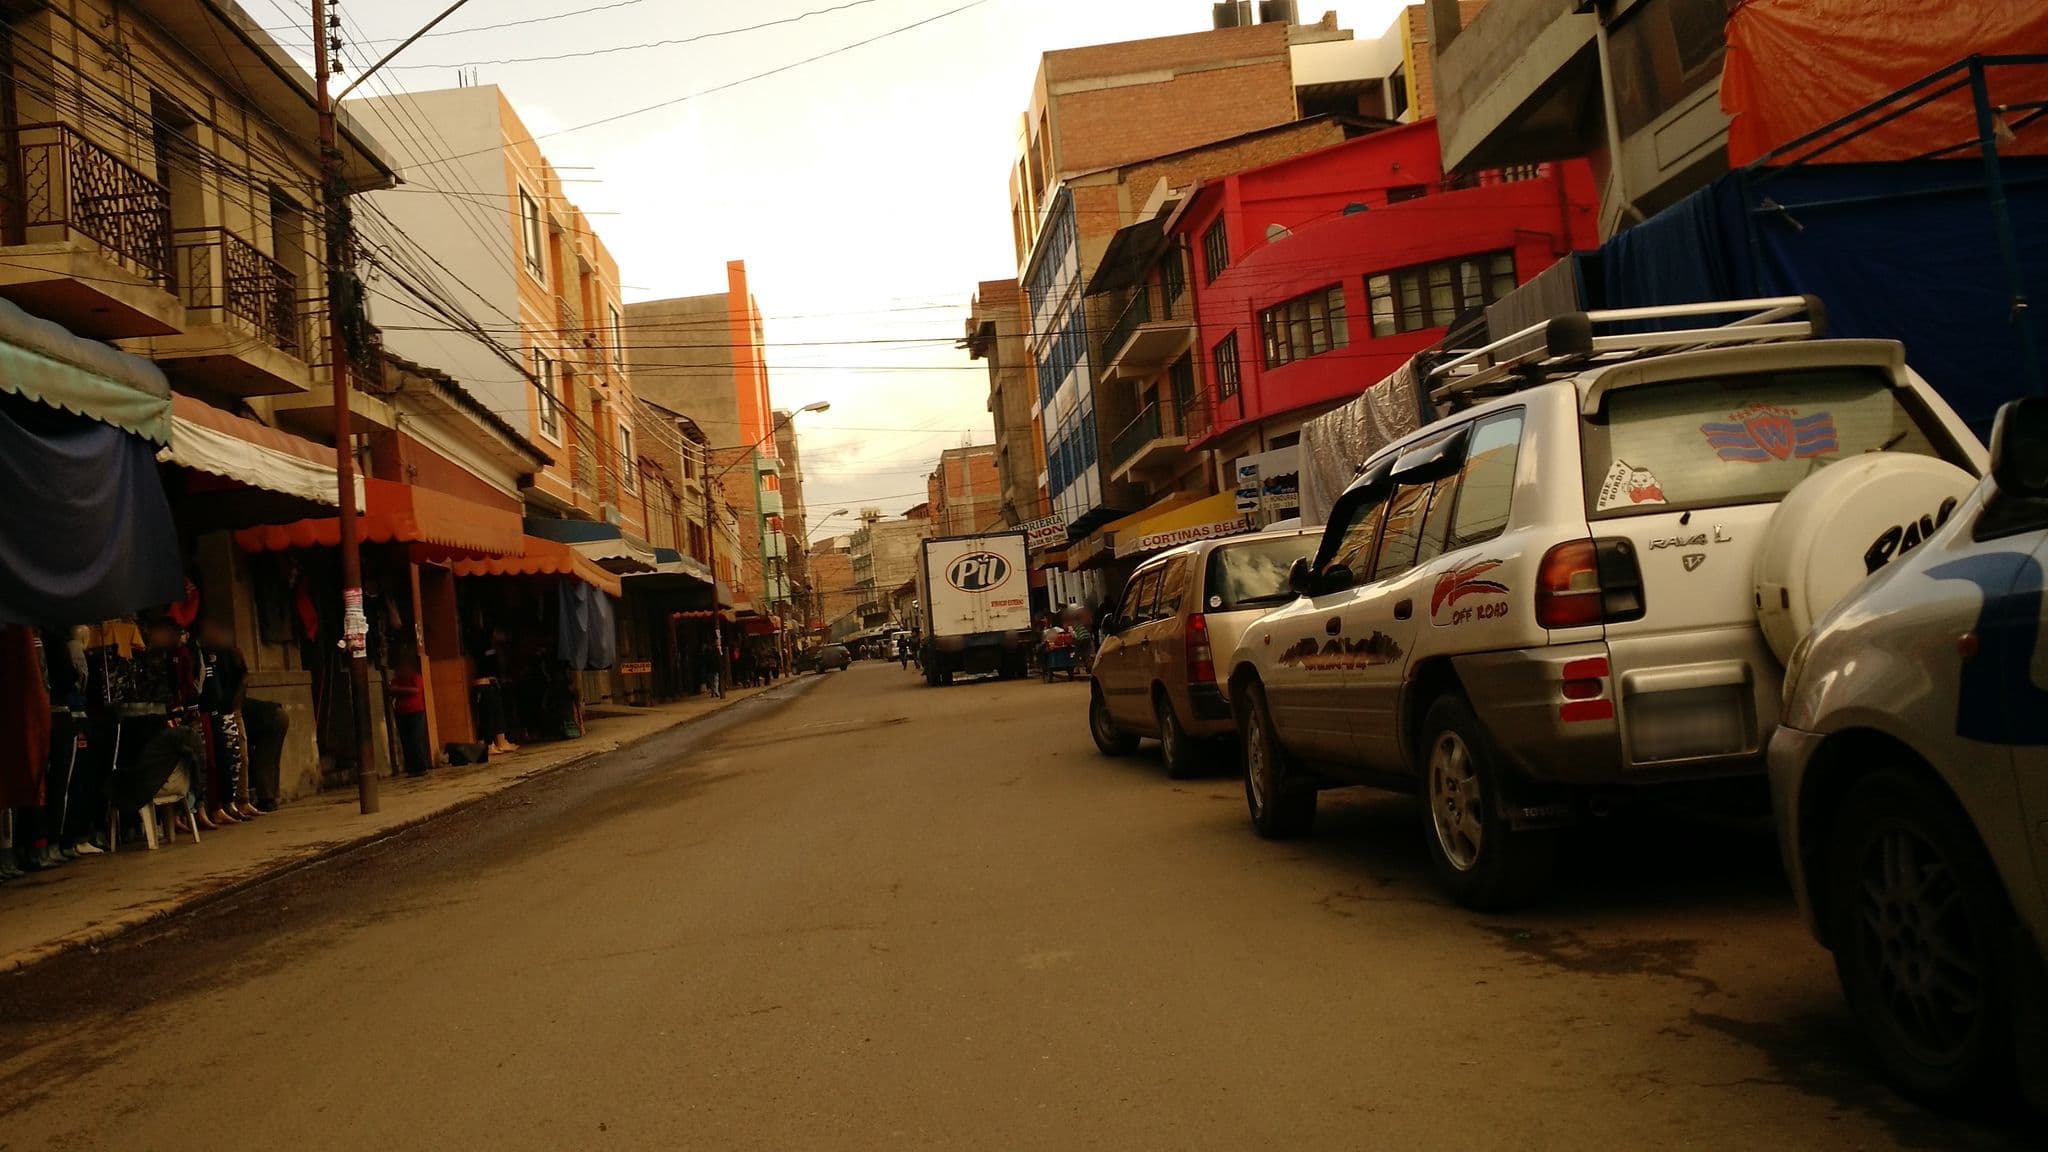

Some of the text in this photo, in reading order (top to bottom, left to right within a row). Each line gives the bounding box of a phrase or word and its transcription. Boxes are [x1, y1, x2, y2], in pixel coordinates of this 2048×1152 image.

[1609, 469, 1626, 501] BORDO
[1028, 524, 1065, 539] NION
[1143, 526, 1210, 546] CORTINAS
[1649, 523, 1732, 551] RAV4 L
[956, 554, 998, 588] Pil
[1452, 602, 1508, 625] OFF ROAD
